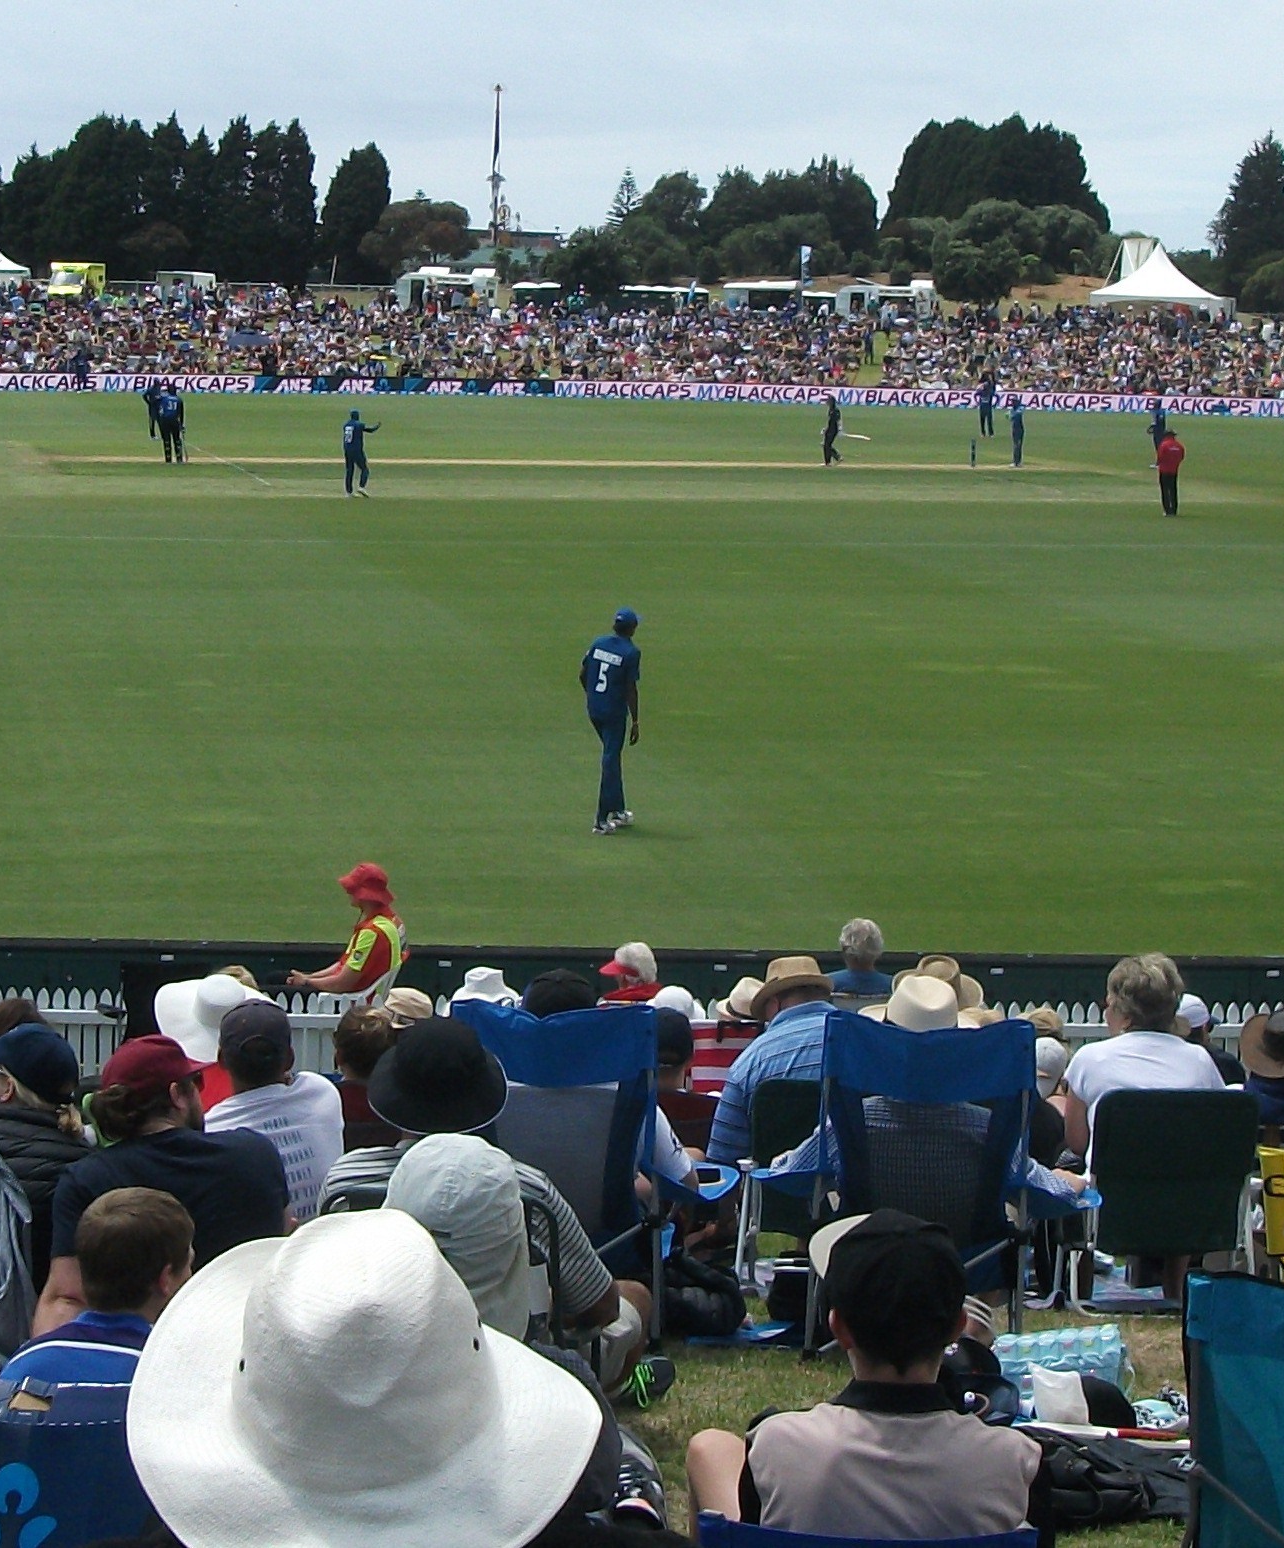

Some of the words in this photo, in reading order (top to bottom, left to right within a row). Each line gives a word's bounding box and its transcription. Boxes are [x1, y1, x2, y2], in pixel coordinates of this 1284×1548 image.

[274, 378, 313, 393] ANZ
[337, 378, 376, 394] ANZ
[426, 380, 463, 394] ANZ
[487, 381, 525, 396] ANZ
[557, 382, 691, 398] MYBLACKCAPS
[837, 389, 972, 406] MYBLACKCAPS
[594, 661, 610, 693] 5
